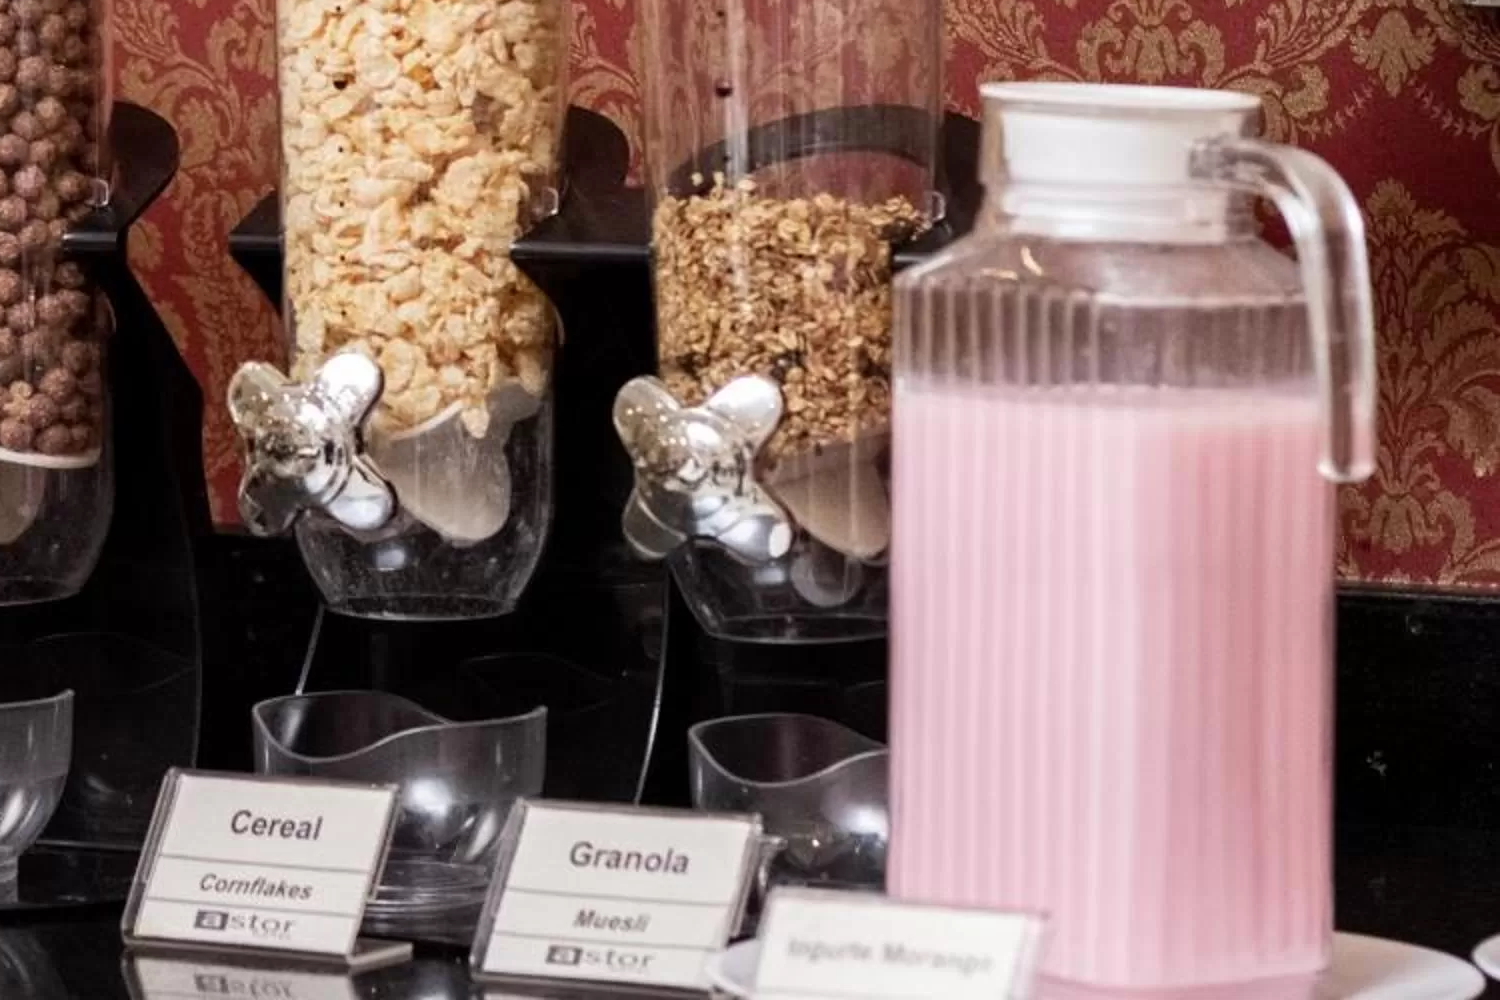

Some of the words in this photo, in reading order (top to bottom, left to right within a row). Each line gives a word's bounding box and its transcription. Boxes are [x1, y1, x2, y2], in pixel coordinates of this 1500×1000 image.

[231, 810, 323, 840] Cereal
[569, 841, 690, 875] Granola
[199, 873, 313, 900] Cornflakes
[194, 910, 294, 932] astor
[575, 910, 649, 932] Muesli
